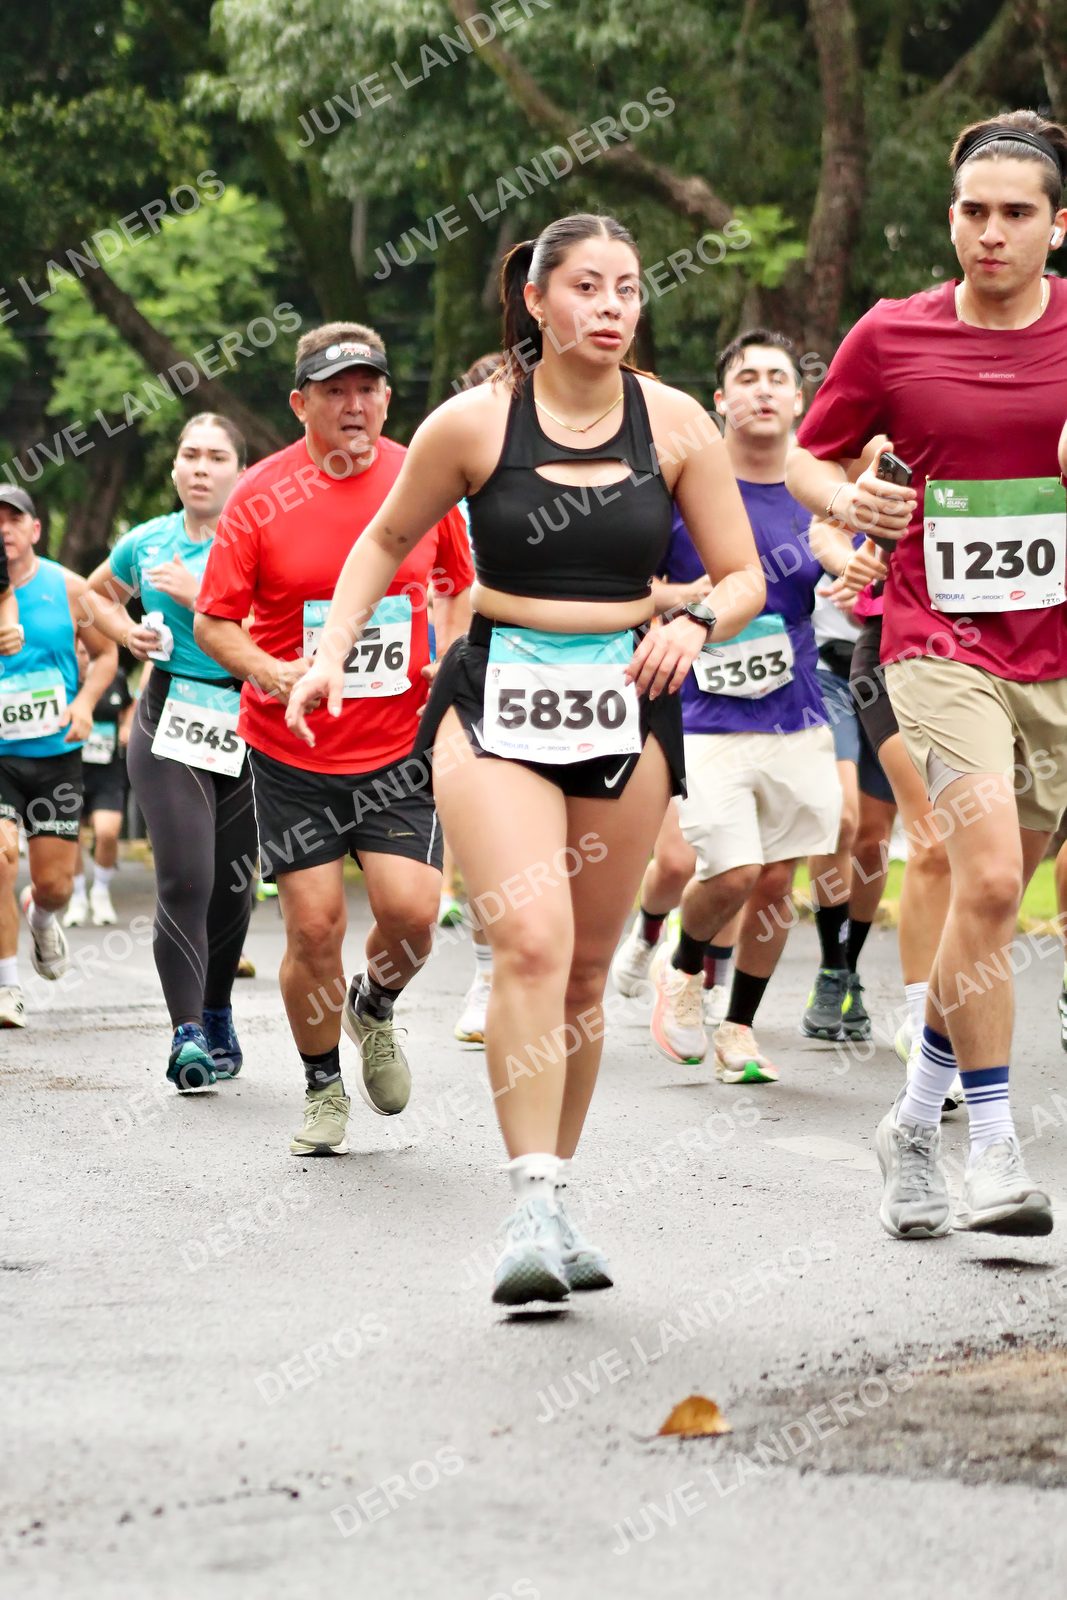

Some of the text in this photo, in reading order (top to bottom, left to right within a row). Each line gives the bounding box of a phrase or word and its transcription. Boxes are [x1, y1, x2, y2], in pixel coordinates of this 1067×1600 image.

[936, 538, 1056, 580] 1230
[342, 641, 404, 674] 276
[704, 650, 787, 692] 5363
[3, 699, 59, 723] 6871
[496, 689, 627, 730] 5830
[164, 715, 239, 753] 5645
